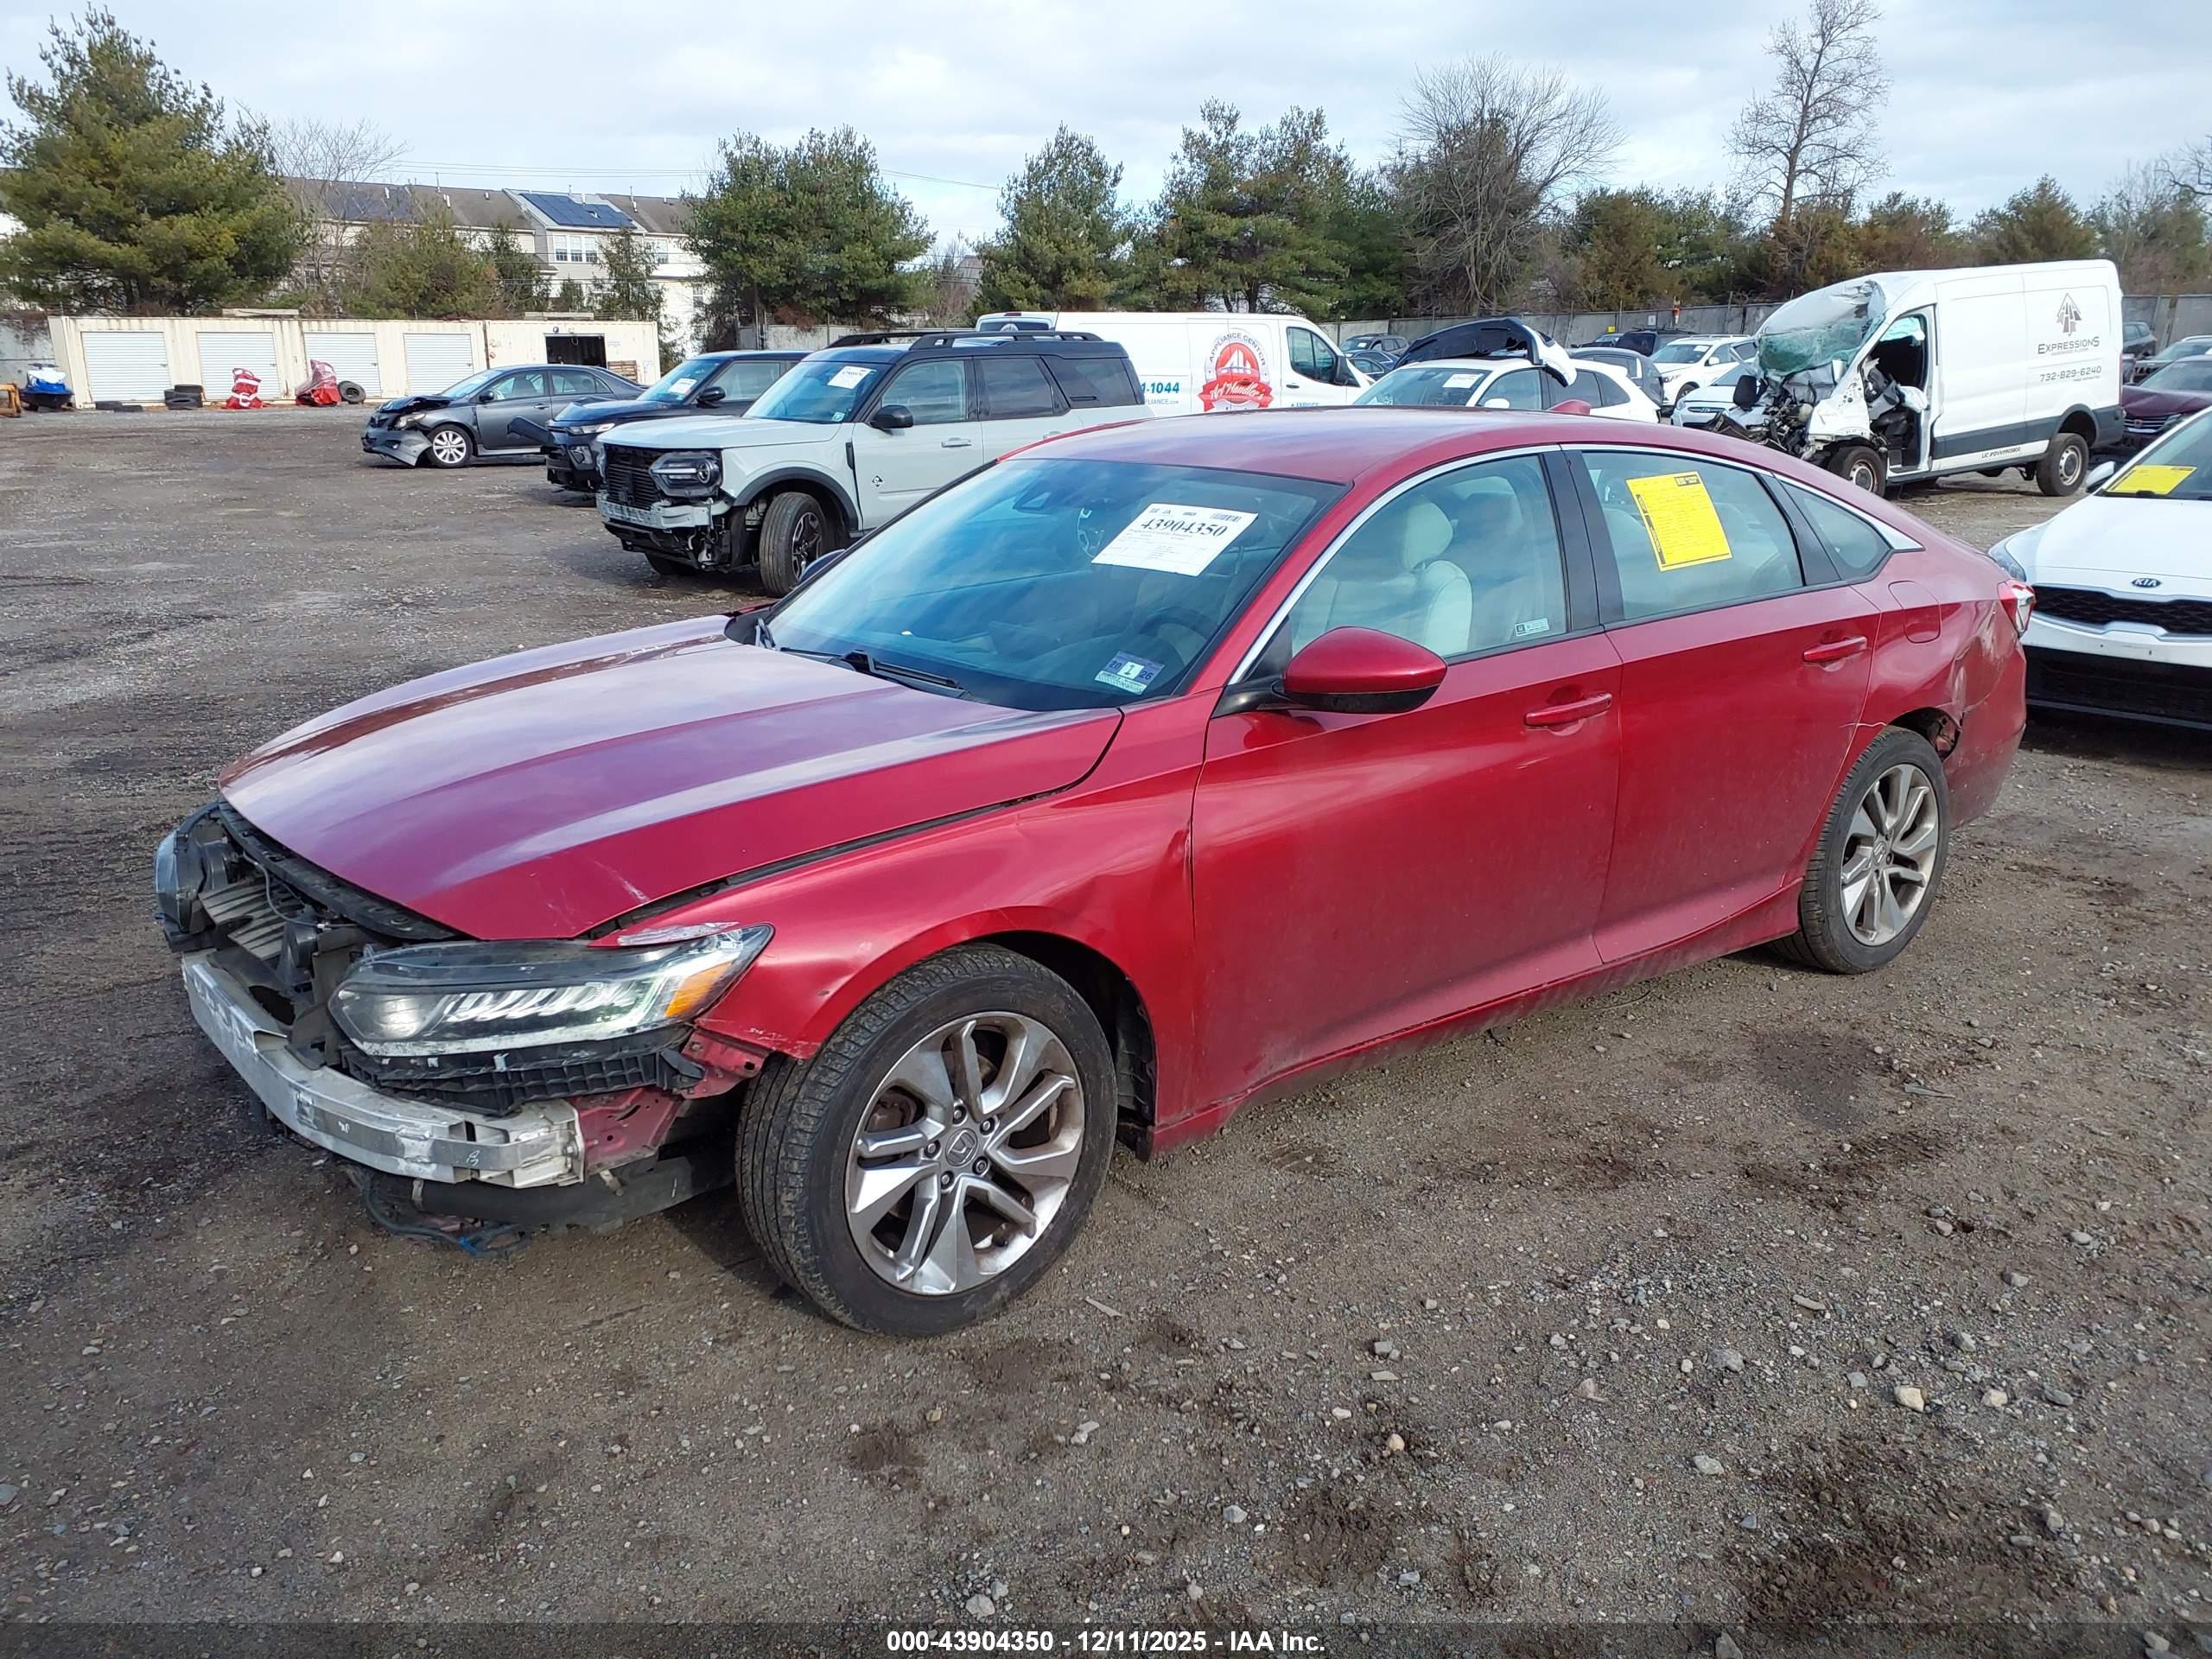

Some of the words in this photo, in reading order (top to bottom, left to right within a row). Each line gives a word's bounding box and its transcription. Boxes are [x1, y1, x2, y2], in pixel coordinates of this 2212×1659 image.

[1209, 333, 1242, 364] APPLIANCE
[1243, 334, 1266, 365] CENTER
[2037, 336, 2100, 354] EXPRESSIONS
[2039, 365, 2102, 382] 732-829-6240
[1210, 381, 1227, 400] Art
[1225, 380, 1266, 400] Handler's
[1141, 518, 1228, 537] 43904350
[2134, 578, 2158, 588] KIA
[1109, 660, 1122, 670] 20
[1123, 664, 1135, 676] 1
[1139, 671, 1154, 680] 26
